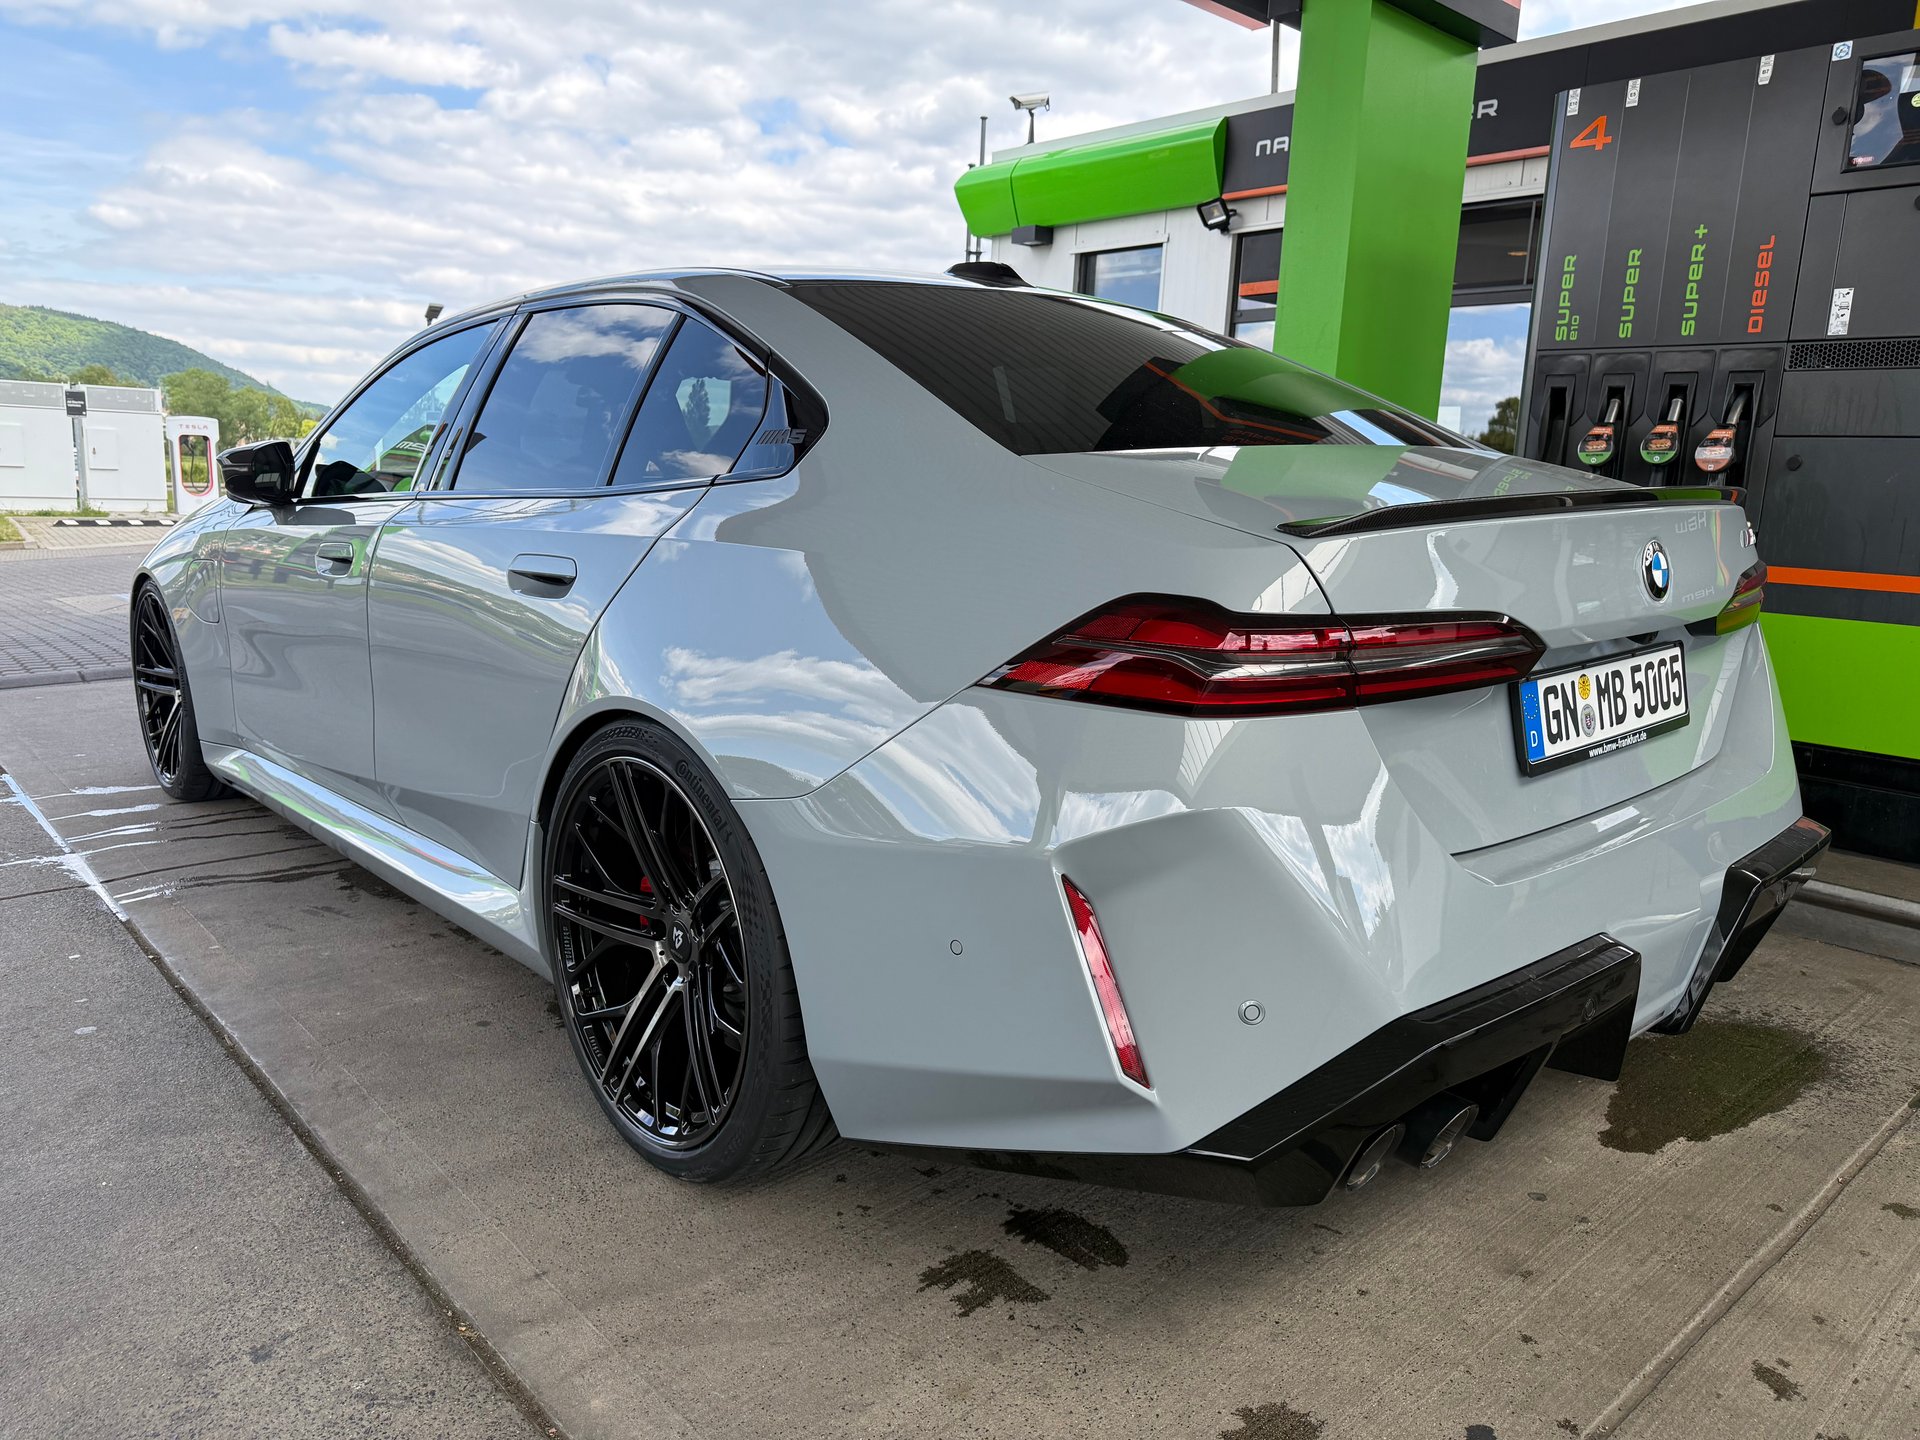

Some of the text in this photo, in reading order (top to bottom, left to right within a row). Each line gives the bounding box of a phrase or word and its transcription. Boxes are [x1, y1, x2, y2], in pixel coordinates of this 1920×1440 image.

[1470, 98, 1499, 120] R
[1569, 115, 1612, 151] 4
[1555, 254, 1577, 342] SUPER
[1618, 248, 1643, 339] SUPER
[1747, 234, 1776, 333] DIESEL
[1543, 654, 1683, 745] GN MB 5005
[1530, 730, 1539, 748] D
[1588, 730, 1647, 758] www.bmw-frankfurt.de
[675, 759, 728, 833] Continental
